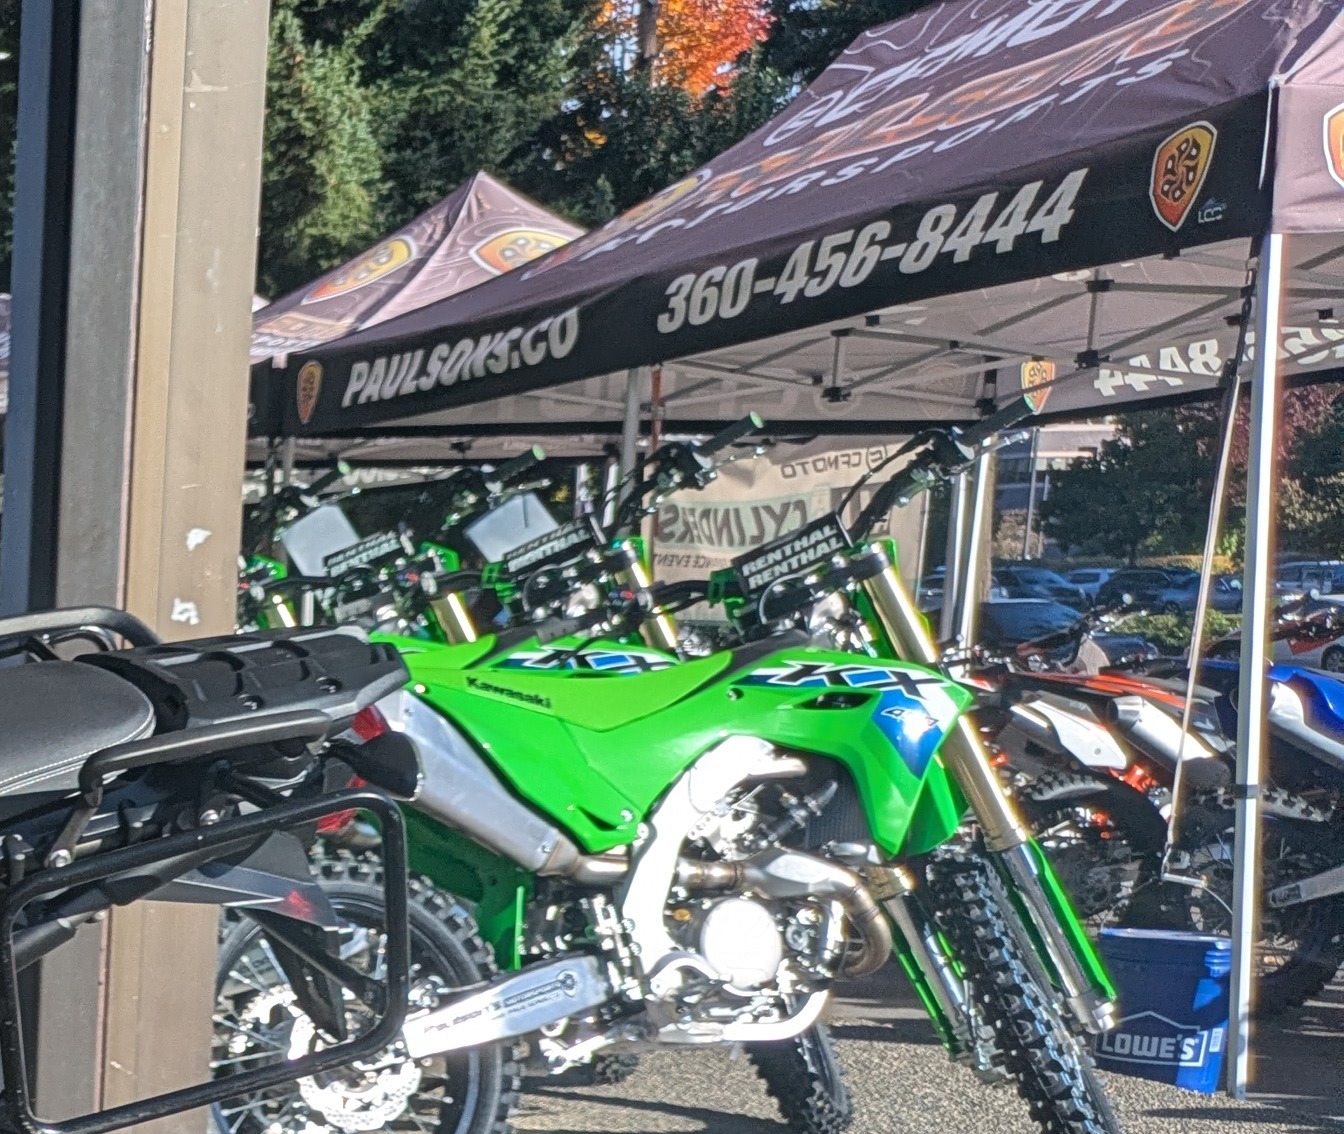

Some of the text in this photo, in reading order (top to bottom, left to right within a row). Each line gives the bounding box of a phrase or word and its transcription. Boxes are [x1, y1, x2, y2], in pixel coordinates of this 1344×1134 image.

[655, 168, 1090, 335] 360-456-8444
[341, 307, 581, 408] PAULSONS.CO
[742, 525, 837, 577] RENTHAL
[748, 537, 844, 590] RENTHAL
[465, 676, 552, 709] Kawasaki
[769, 663, 950, 701] KX
[1101, 1033, 1197, 1060] LOWE'S
